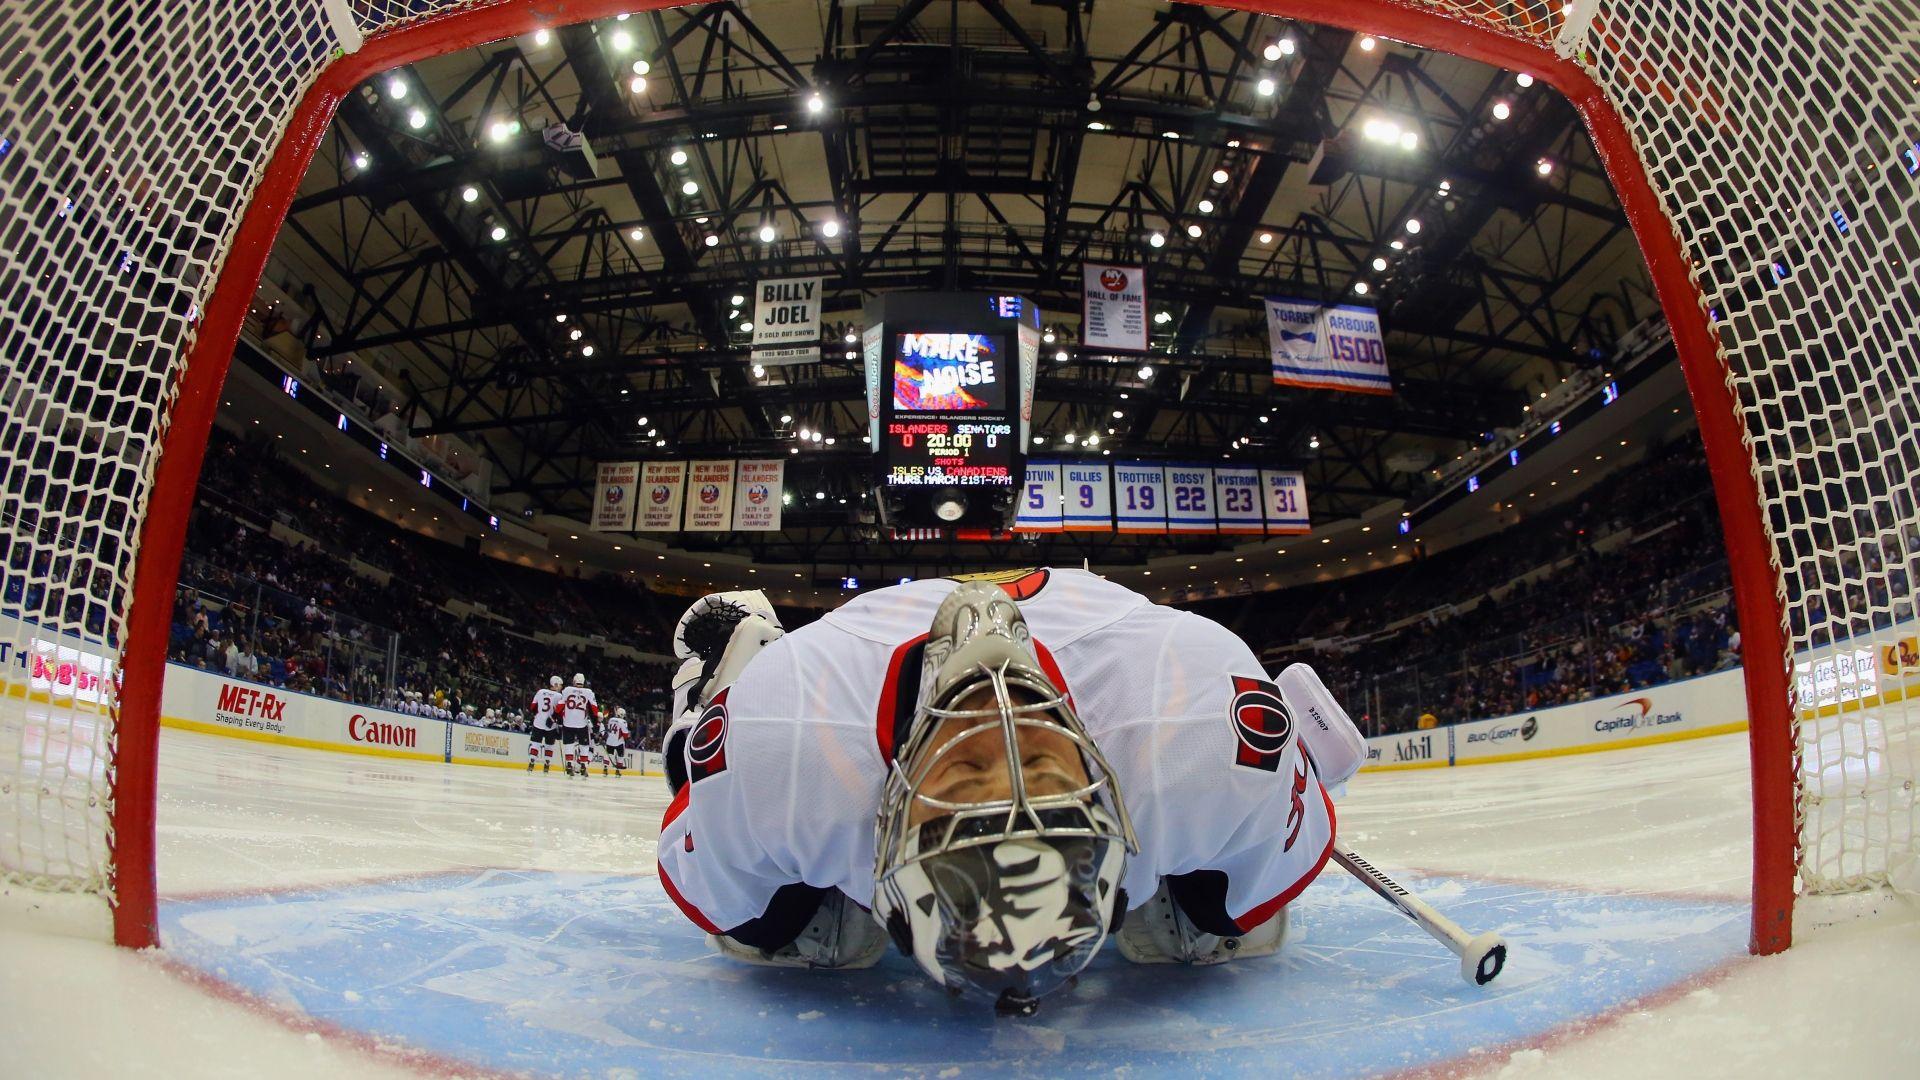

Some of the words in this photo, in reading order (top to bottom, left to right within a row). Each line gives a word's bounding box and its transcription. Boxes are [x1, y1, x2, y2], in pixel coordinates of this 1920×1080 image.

[763, 282, 815, 302] BILLY
[1088, 291, 1106, 300] HALL
[1110, 293, 1118, 301] OF
[1122, 294, 1141, 302] FAME
[765, 306, 810, 326] JOEL
[1273, 308, 1316, 324] TORREY
[1329, 316, 1376, 333] ARBOUR
[1330, 334, 1385, 365] 1500
[920, 360, 996, 394] NOISE
[889, 424, 948, 434] ISLANDERS
[957, 425, 1011, 434] SENATORS
[903, 434, 913, 447] 0
[927, 434, 972, 447] 20:00
[987, 435, 997, 447] 0
[929, 448, 960, 456] PERIOD
[964, 448, 970, 456] 1
[713, 464, 729, 472] YORK
[892, 467, 924, 475] ISLES
[946, 467, 1007, 475] CANADIENS
[646, 476, 680, 484] ISLANDERS
[693, 474, 729, 482] ISLANDERS
[741, 474, 778, 482] ISLANDERS
[924, 475, 958, 485] MARCH
[1025, 471, 1054, 482] OTVIN
[1069, 471, 1102, 482] GILLIES
[1117, 472, 1162, 484] TROTTIER
[1173, 473, 1205, 485] BOSSY
[1217, 475, 1257, 486] NYSTROM
[1270, 477, 1297, 487] SMITH
[1028, 484, 1044, 509] 5
[1079, 485, 1094, 508] 9
[1127, 486, 1155, 510] 19
[1175, 487, 1206, 512] 22
[1225, 488, 1253, 512] 23
[1275, 490, 1297, 513] 31
[542, 698, 551, 712] 3
[566, 694, 587, 710] 62
[216, 713, 243, 726] Shaping
[245, 718, 265, 730] Every
[1308, 706, 1328, 731] BISHOP
[1657, 712, 1682, 724] Bank
[348, 714, 416, 748] Canon
[1467, 733, 1487, 743] BUD
[1492, 728, 1520, 739] LIGHT
[1394, 735, 1432, 762] Advil
